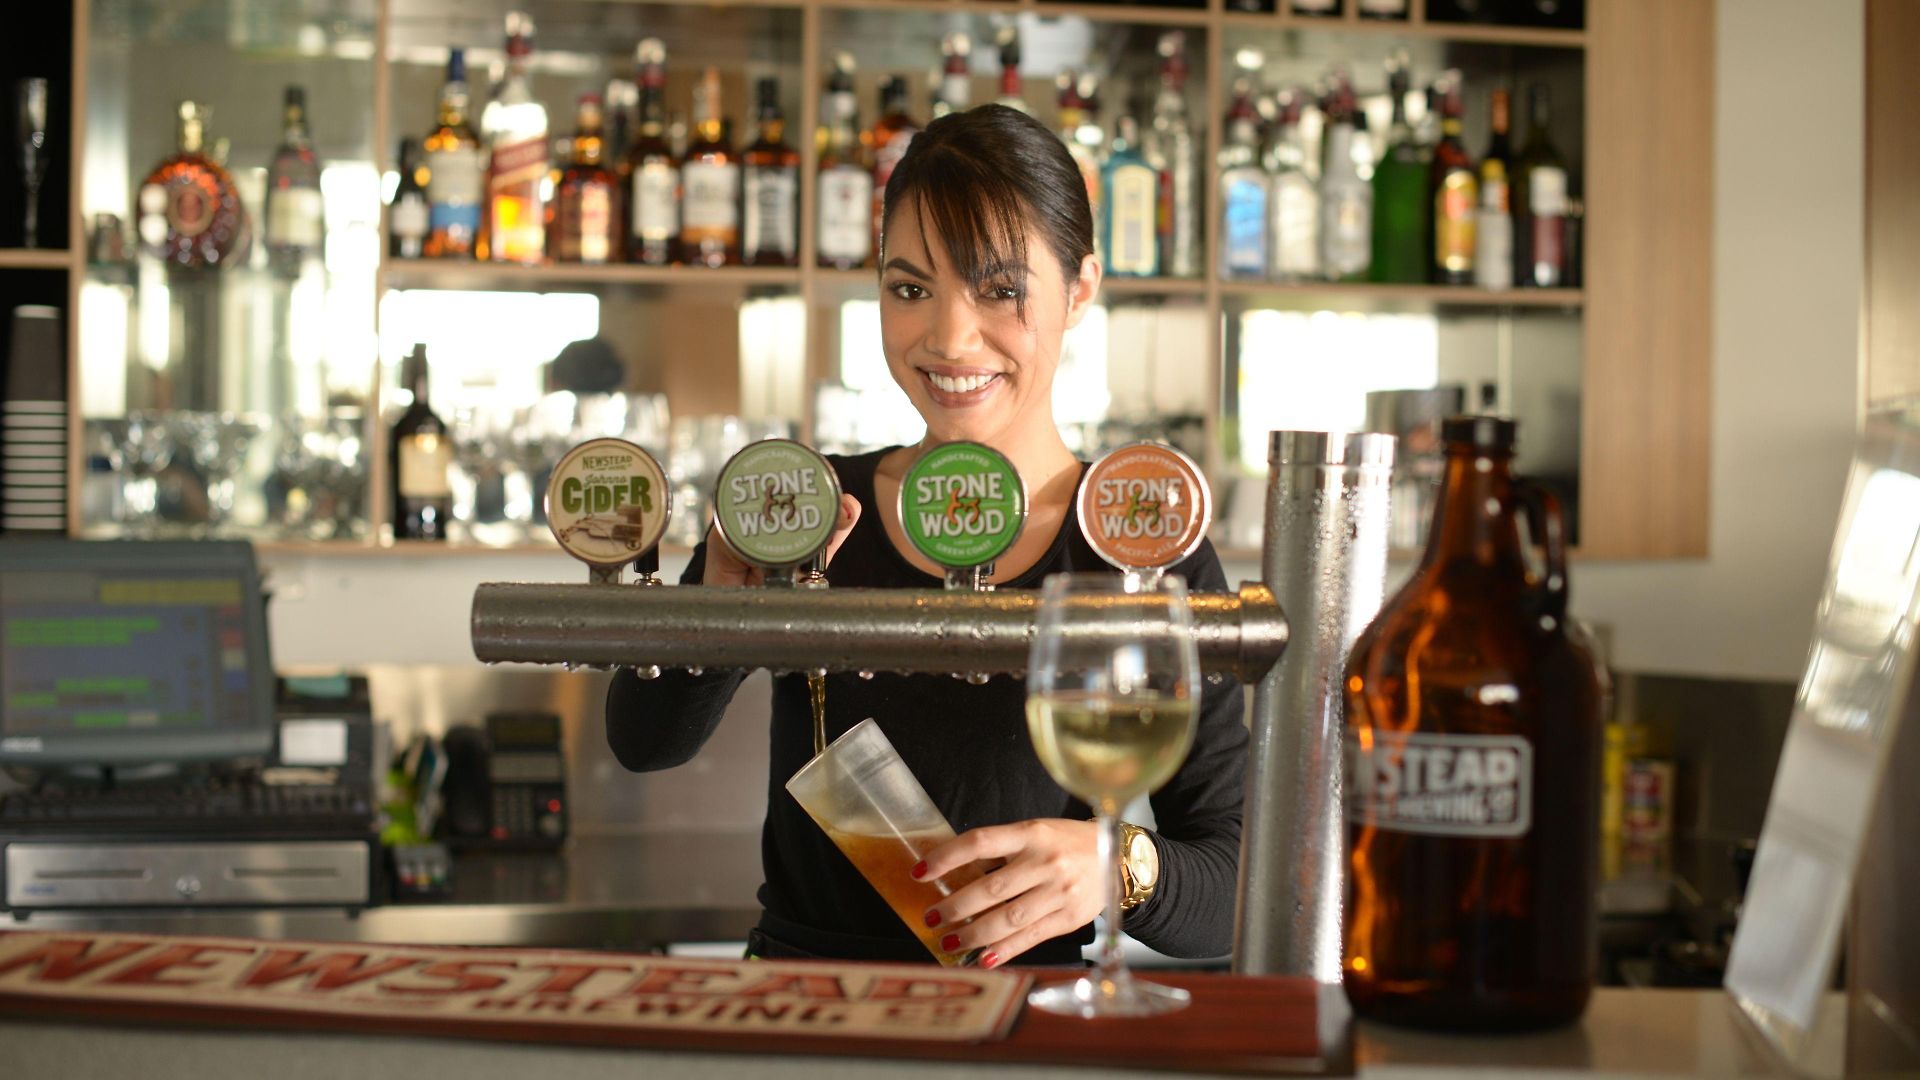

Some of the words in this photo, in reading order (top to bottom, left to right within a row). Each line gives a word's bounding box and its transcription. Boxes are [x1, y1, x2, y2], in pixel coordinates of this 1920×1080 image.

[582, 455, 633, 470] NEWSTEAD
[931, 453, 990, 469] HANDCRAFTED
[562, 476, 653, 514] CIDER
[731, 467, 818, 504] STONE
[916, 472, 1004, 504] STONE
[1098, 478, 1184, 506] STONE
[736, 505, 820, 537] WOOD
[919, 509, 1005, 538] WOOD
[1101, 512, 1184, 539] WOOD
[0, 940, 985, 998] NEWSTEAD
